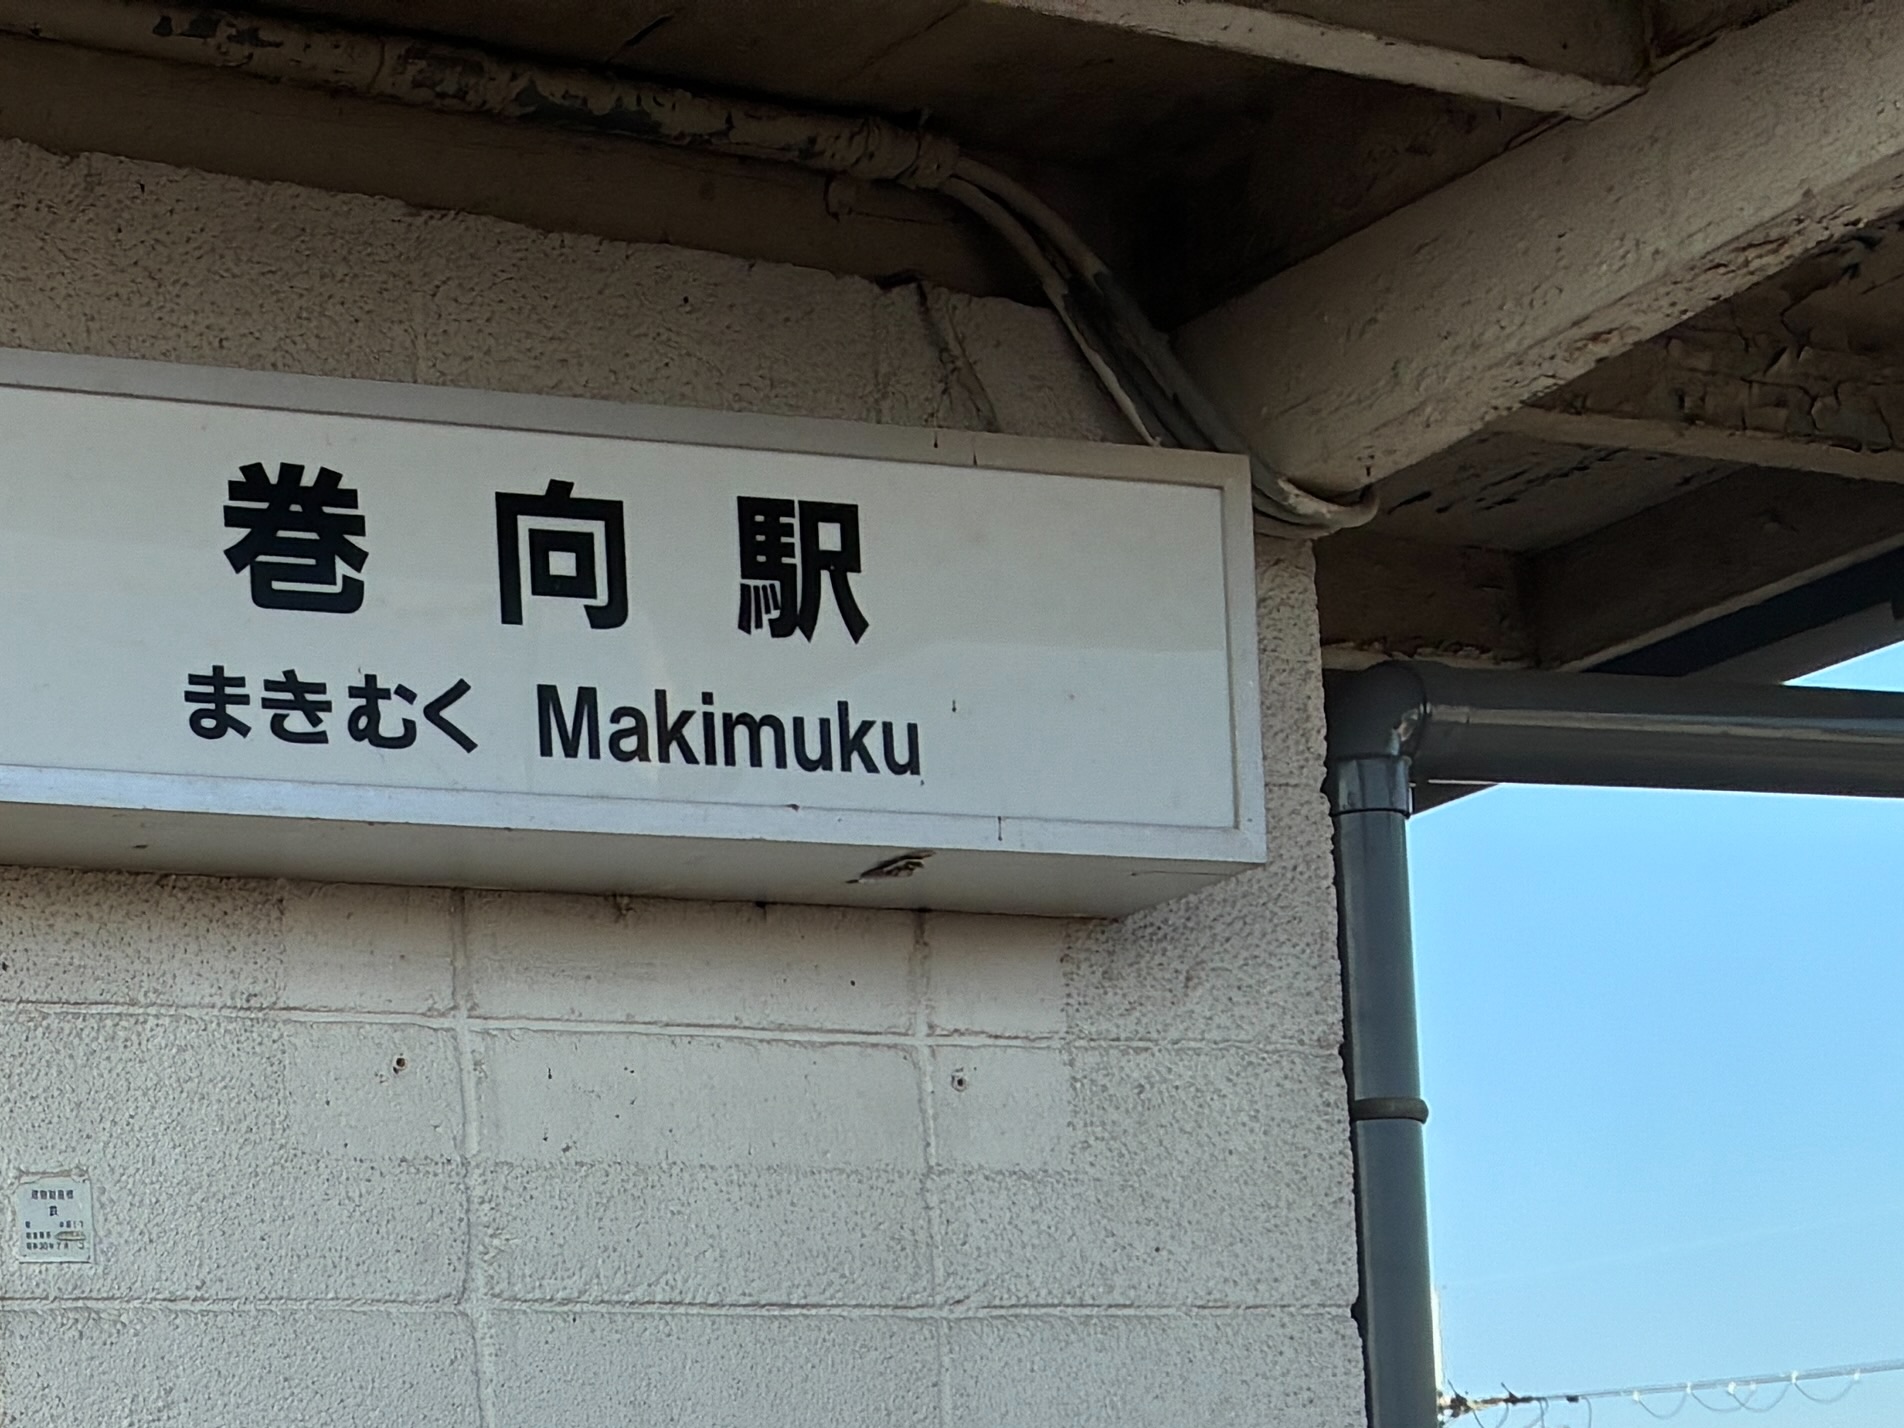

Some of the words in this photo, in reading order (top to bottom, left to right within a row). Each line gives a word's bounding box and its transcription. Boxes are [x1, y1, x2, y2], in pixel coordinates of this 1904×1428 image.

[223, 462, 869, 644] 巻向駅
[184, 664, 479, 754] まきむく
[536, 684, 921, 777] Makimuku
